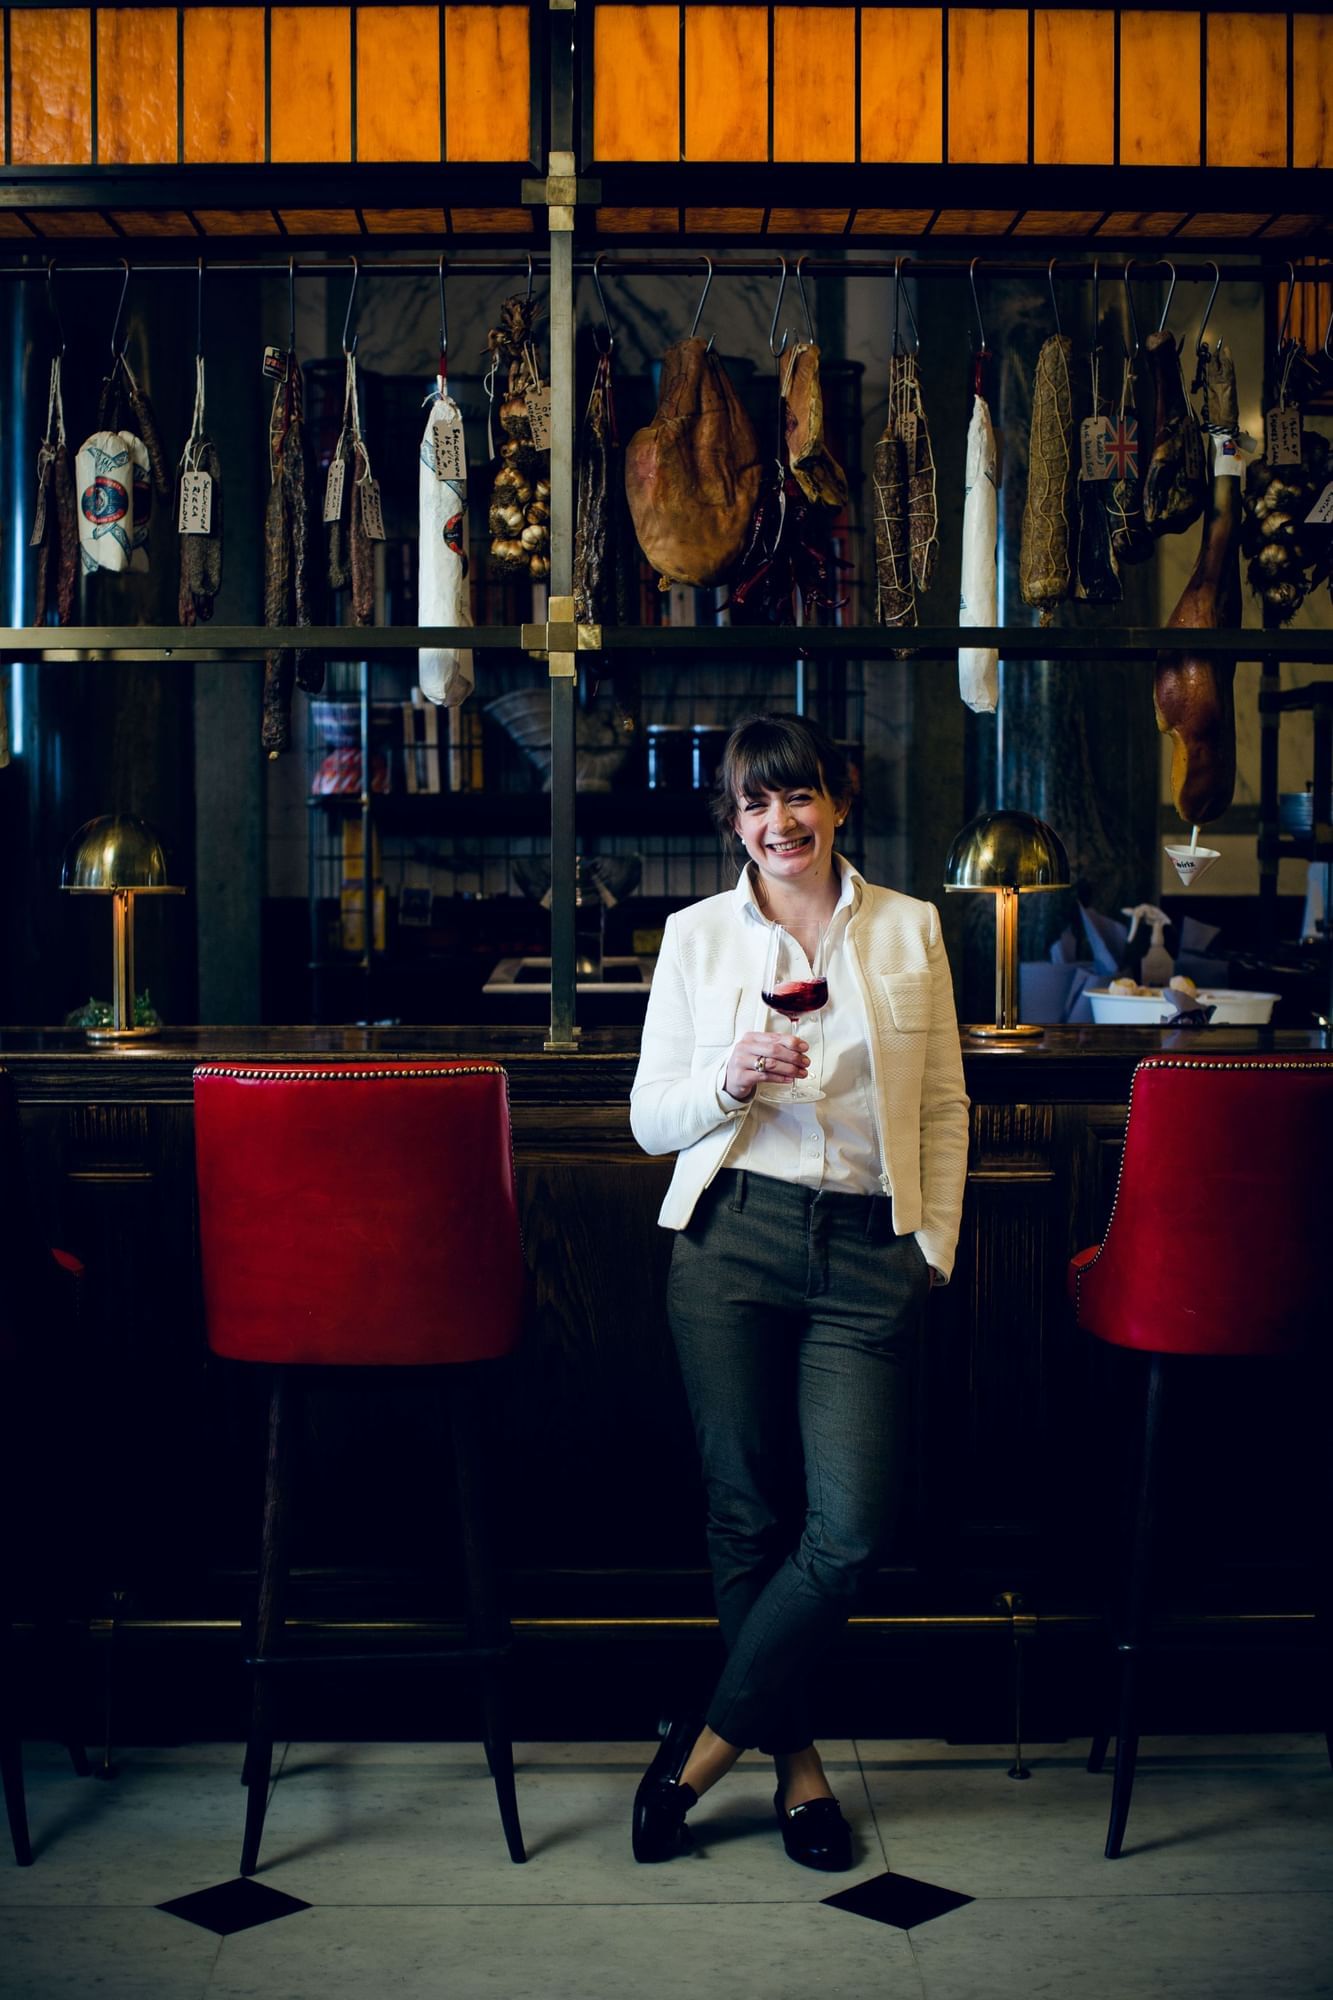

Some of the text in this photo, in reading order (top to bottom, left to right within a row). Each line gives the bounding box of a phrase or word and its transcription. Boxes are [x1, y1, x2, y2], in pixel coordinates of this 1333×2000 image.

[432, 426, 443, 476] CATALONIA
[180, 477, 190, 531] CATALONIA
[191, 486, 201, 517] RIERA
